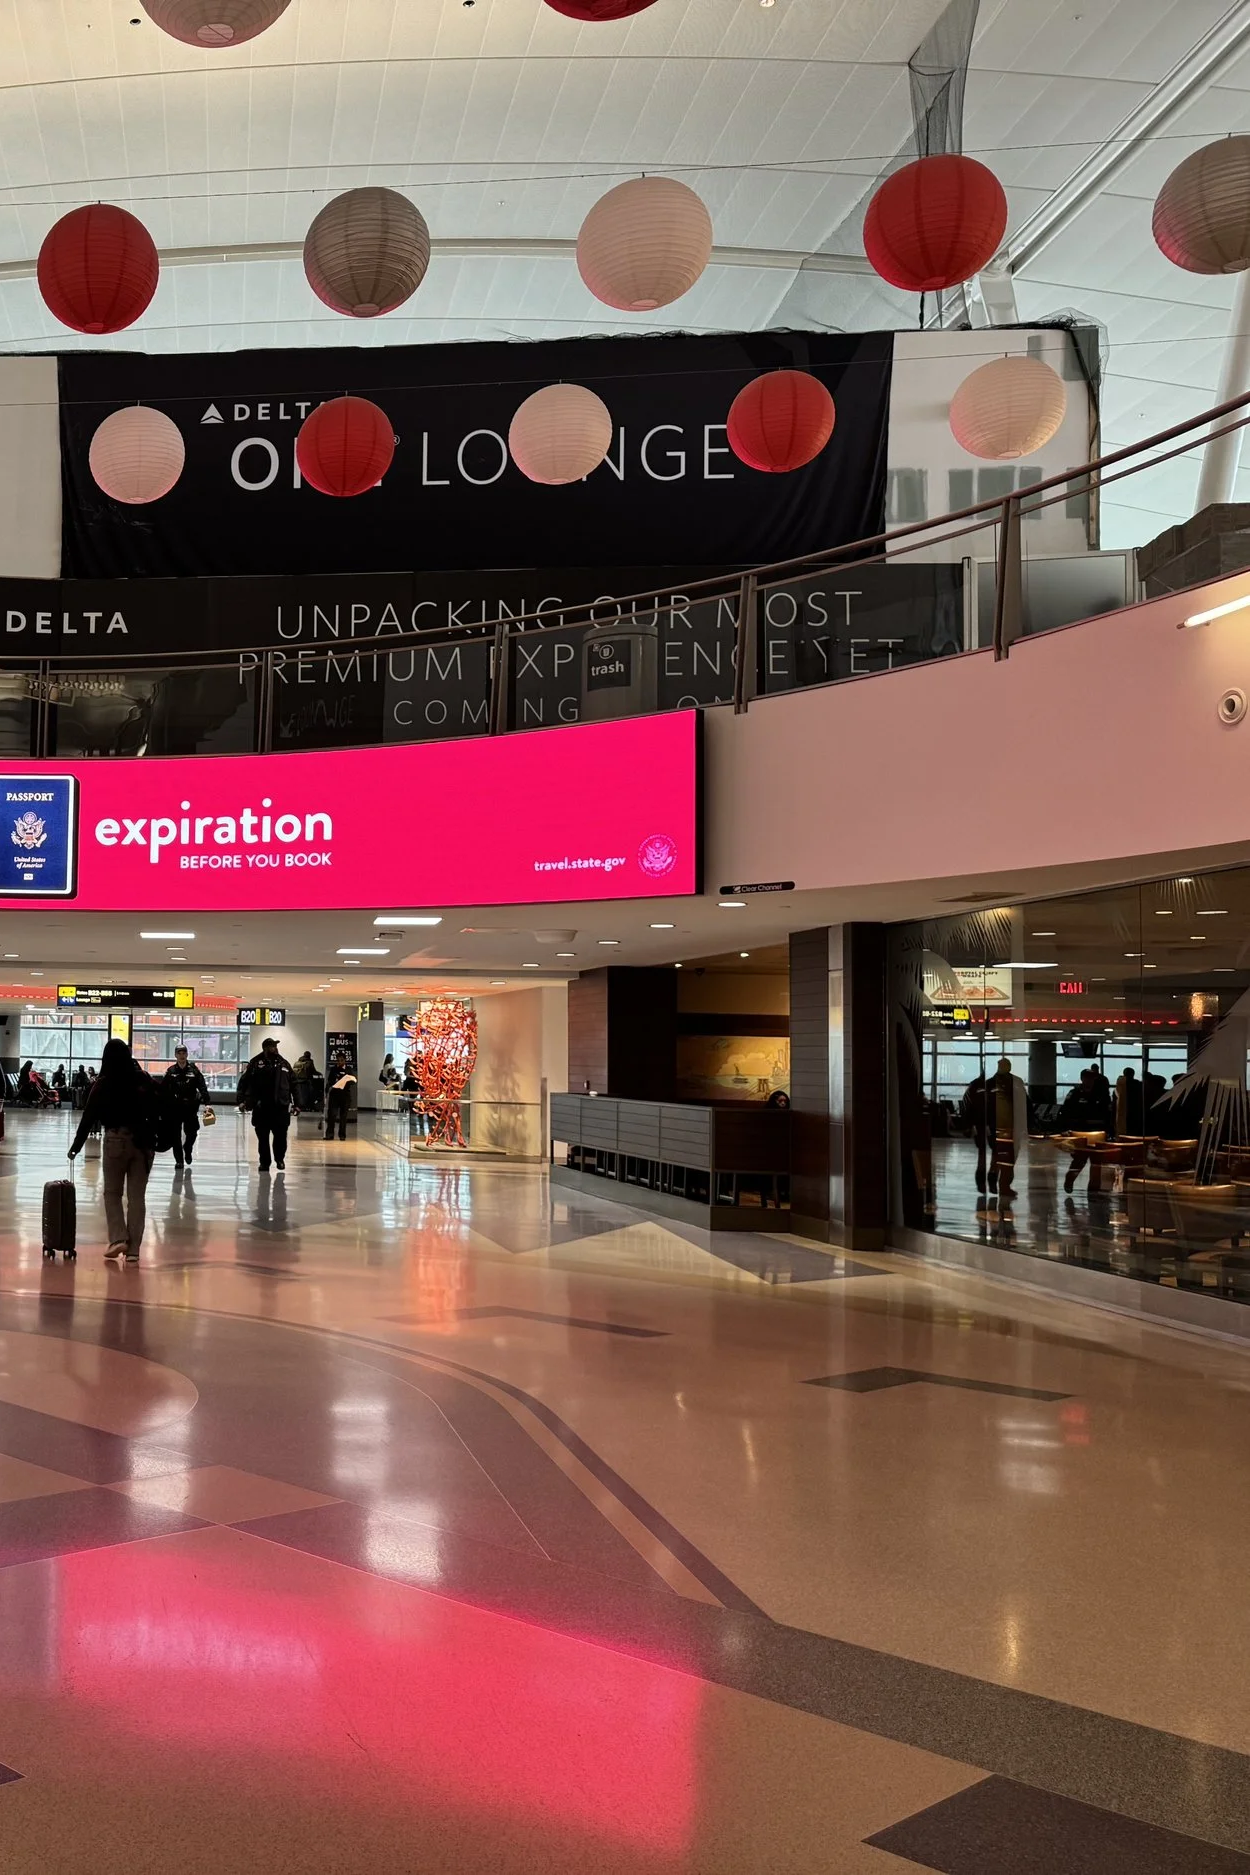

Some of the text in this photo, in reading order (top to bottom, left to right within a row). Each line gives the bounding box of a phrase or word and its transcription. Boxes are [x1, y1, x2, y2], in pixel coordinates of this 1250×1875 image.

[233, 402, 327, 421] DELT
[421, 424, 735, 486] LONGE
[6, 610, 129, 634] DELTA
[277, 597, 564, 639] UNPACKING
[590, 594, 693, 629] OUR
[239, 646, 463, 685] PREMIUM
[591, 660, 625, 677] trash
[393, 697, 579, 725] COMNG
[6, 792, 55, 801] PASSPORT
[95, 797, 333, 864] expiration
[179, 852, 332, 869] BEFORE YOU BOOK
[534, 856, 627, 872] travel.state.gov
[741, 883, 783, 892] Clear Channel
[241, 1010, 256, 1023] B20
[269, 1010, 282, 1024] B20
